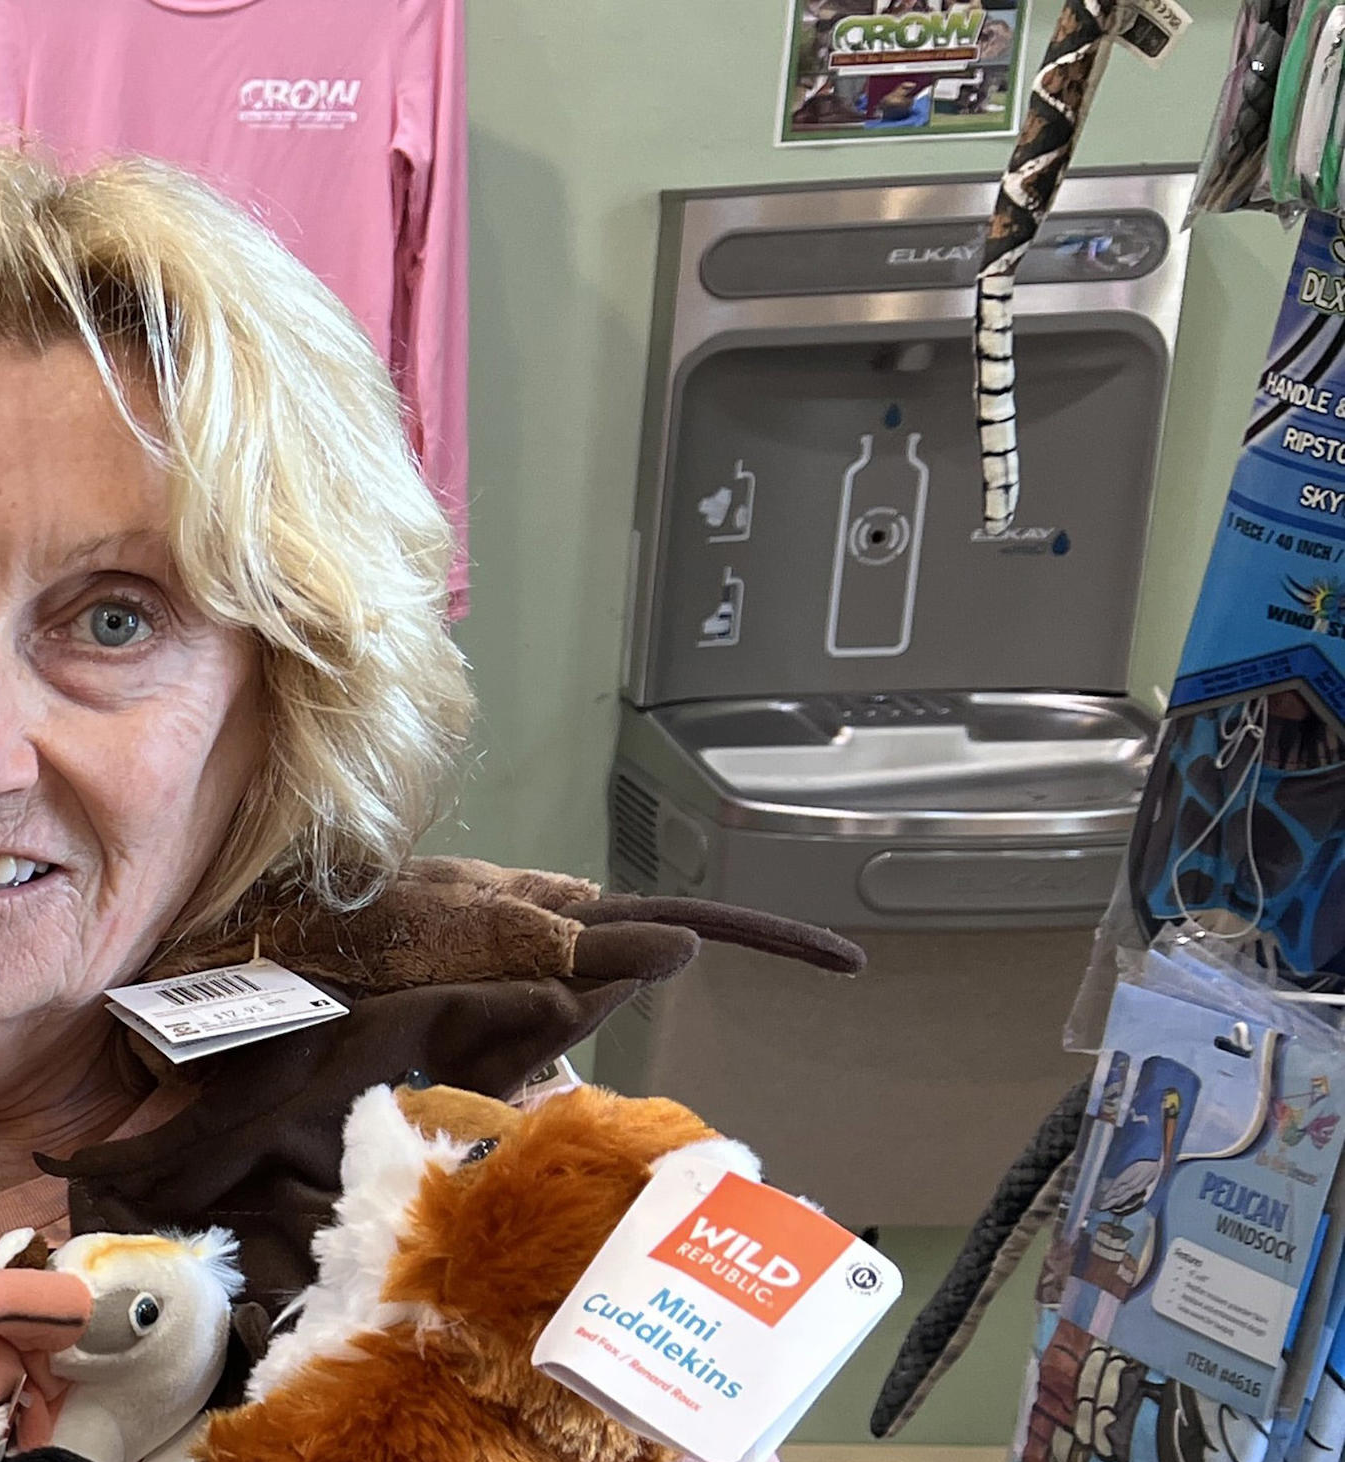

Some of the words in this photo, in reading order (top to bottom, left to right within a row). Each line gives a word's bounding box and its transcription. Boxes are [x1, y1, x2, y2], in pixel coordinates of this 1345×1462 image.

[833, 10, 987, 52] CROW
[241, 79, 361, 110] CROW
[887, 244, 980, 264] ELKAY
[1266, 373, 1332, 414] HANDLE
[1300, 485, 1345, 513] SKY
[1234, 517, 1265, 541] PIECE
[1296, 539, 1333, 560] INCH
[1199, 1171, 1289, 1232] PELICAN
[688, 1216, 801, 1288] WILD
[1216, 1214, 1298, 1263] WINDSOCK
[676, 1243, 773, 1305] REPUBLIC
[648, 1287, 722, 1342] Mini
[575, 1326, 598, 1344] Red
[598, 1337, 619, 1358] Fox
[629, 1358, 672, 1393] Renard
[671, 1384, 702, 1412] Roux
[582, 1293, 743, 1400] Cuddlekins
[1186, 1352, 1218, 1377] ITEM
[1219, 1368, 1262, 1398] #4616
